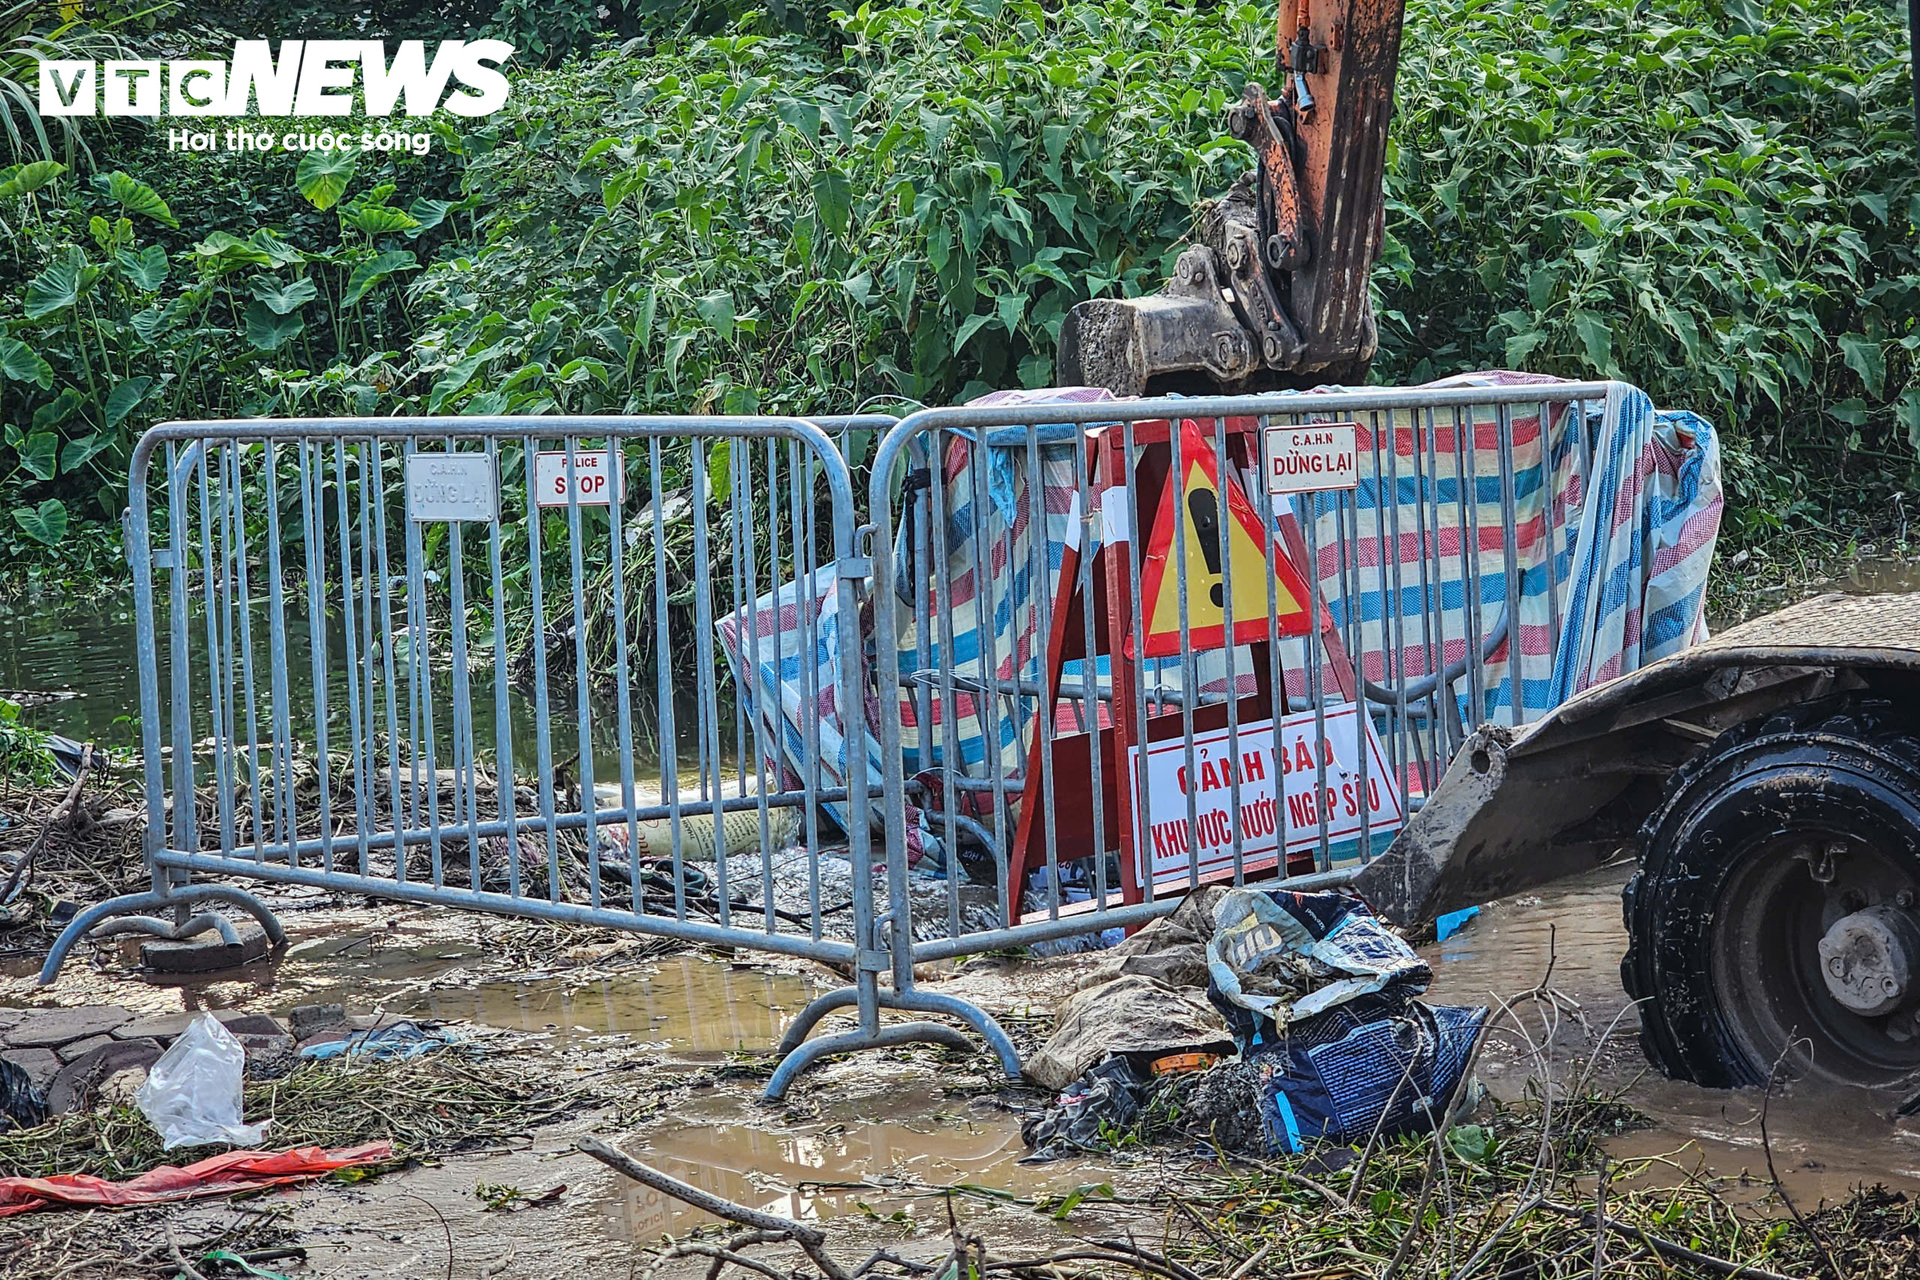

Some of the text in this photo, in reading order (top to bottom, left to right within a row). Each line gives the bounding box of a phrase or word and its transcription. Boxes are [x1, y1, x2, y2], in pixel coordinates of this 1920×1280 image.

[1292, 432, 1334, 446] C.A.H.N
[562, 457, 598, 468] PLICE
[1273, 449, 1352, 476] DỪNG LẠI
[555, 475, 605, 494] SOP
[1176, 734, 1334, 796] CẢNH BÁO
[1151, 818, 1190, 860] KHU
[1195, 808, 1232, 855] VỰC
